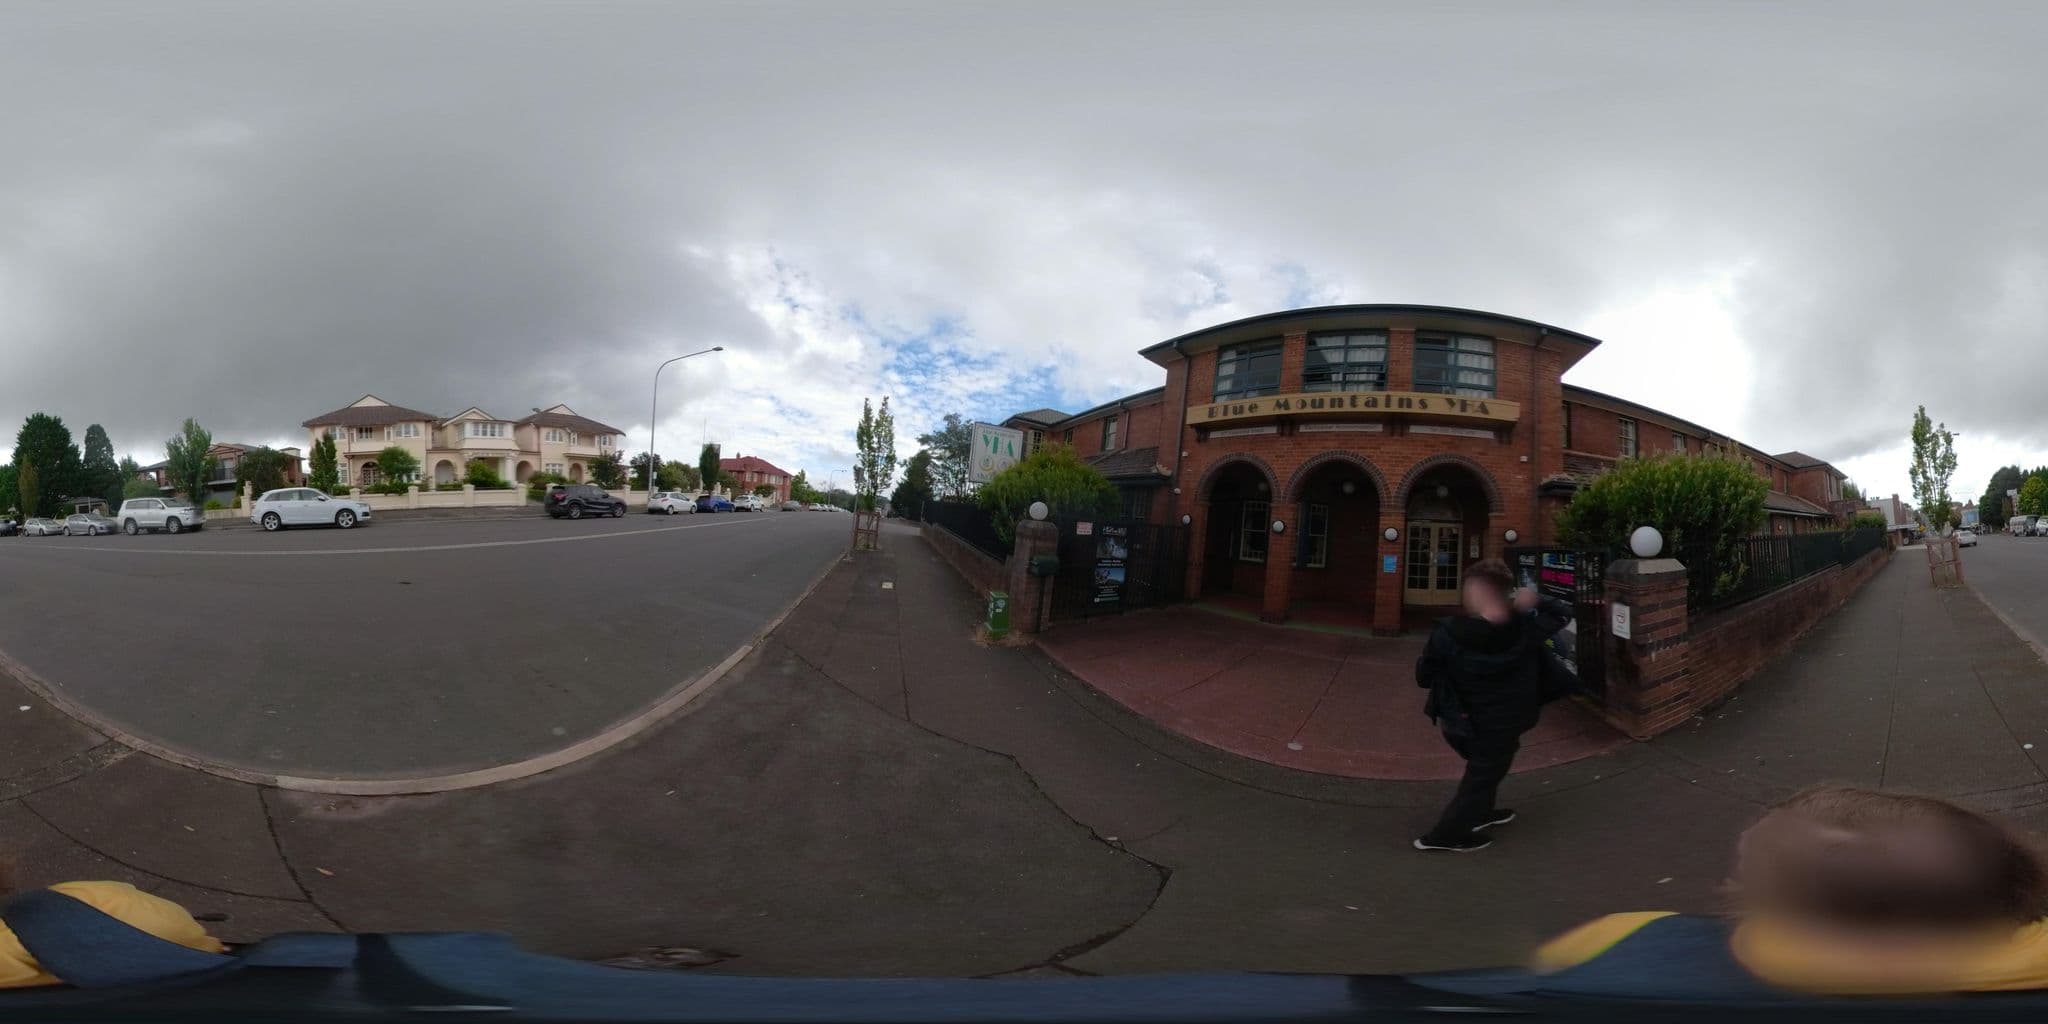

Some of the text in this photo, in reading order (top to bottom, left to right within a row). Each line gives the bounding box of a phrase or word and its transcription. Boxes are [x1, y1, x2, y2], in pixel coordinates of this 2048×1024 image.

[1208, 394, 1489, 418] Blue Mountains YHA
